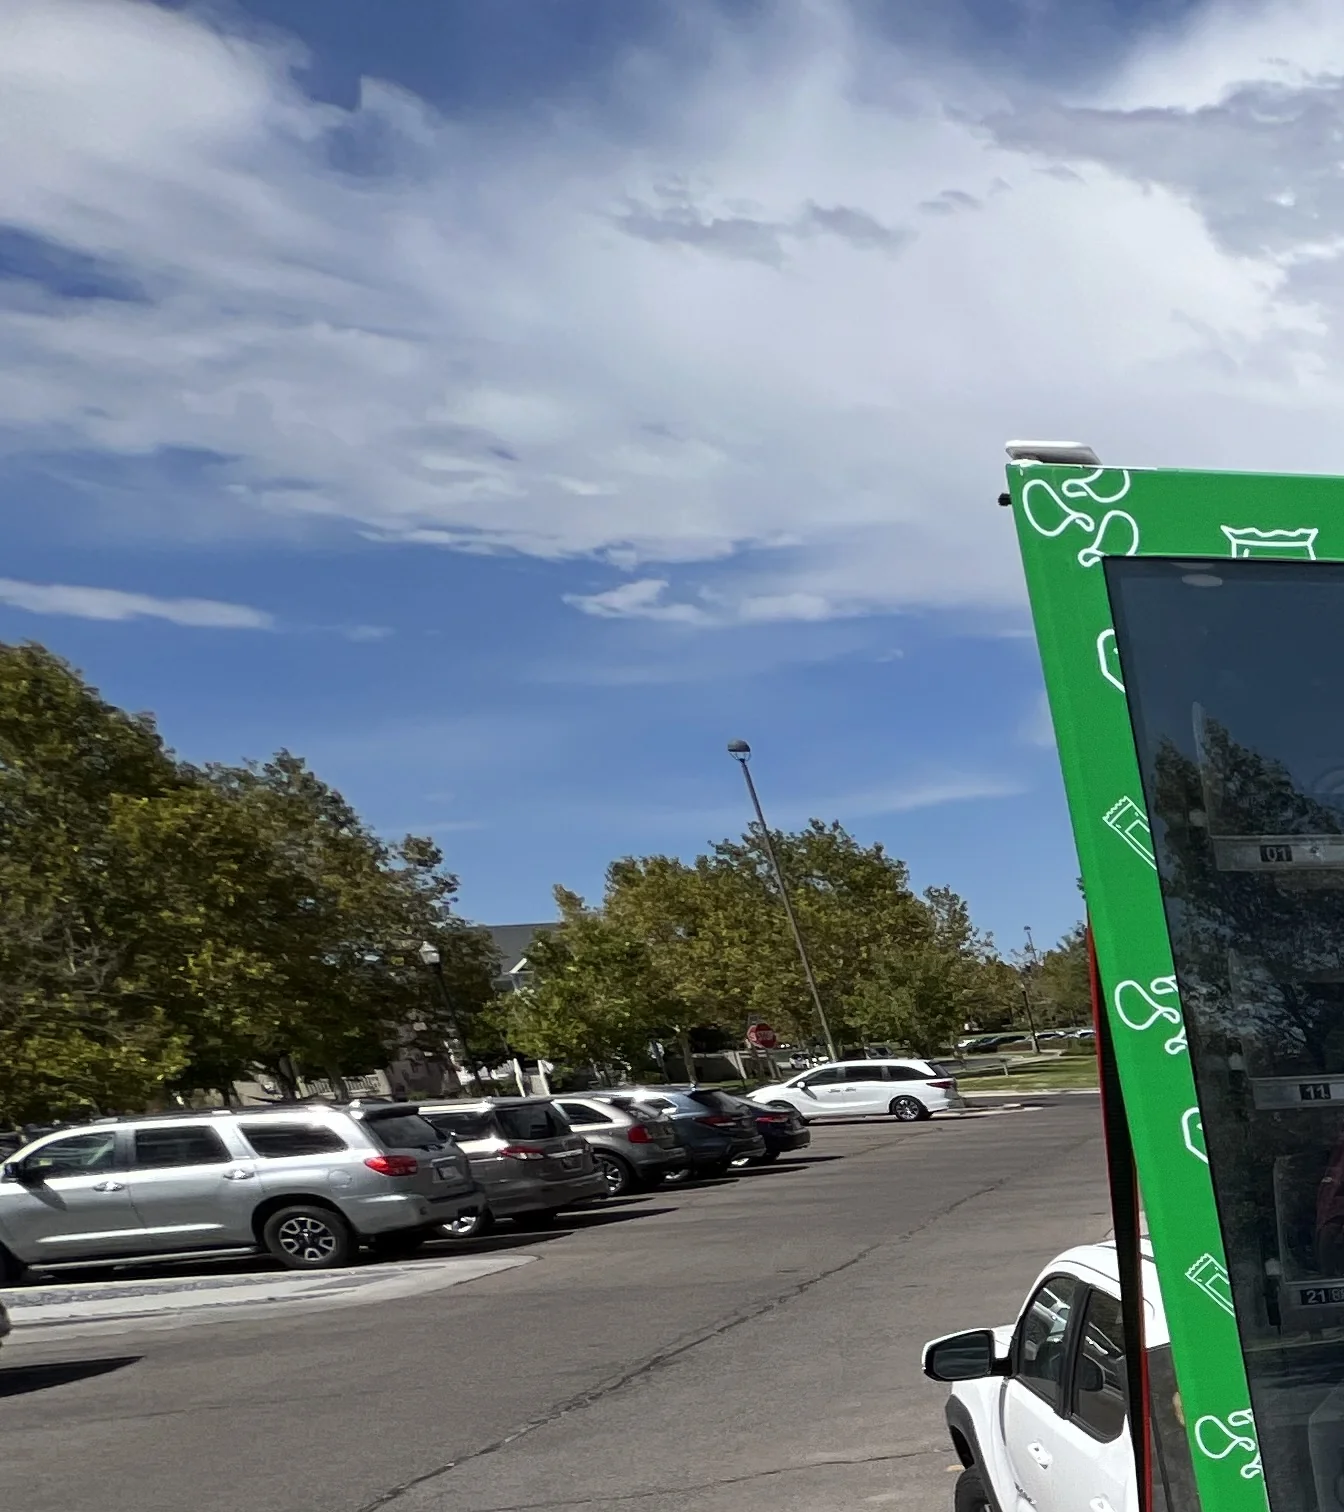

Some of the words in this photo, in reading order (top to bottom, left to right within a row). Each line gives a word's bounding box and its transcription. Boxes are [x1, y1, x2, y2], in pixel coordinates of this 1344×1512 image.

[1266, 846, 1289, 862] 01
[1305, 1085, 1328, 1100] 11
[1305, 1289, 1326, 1304] 21
